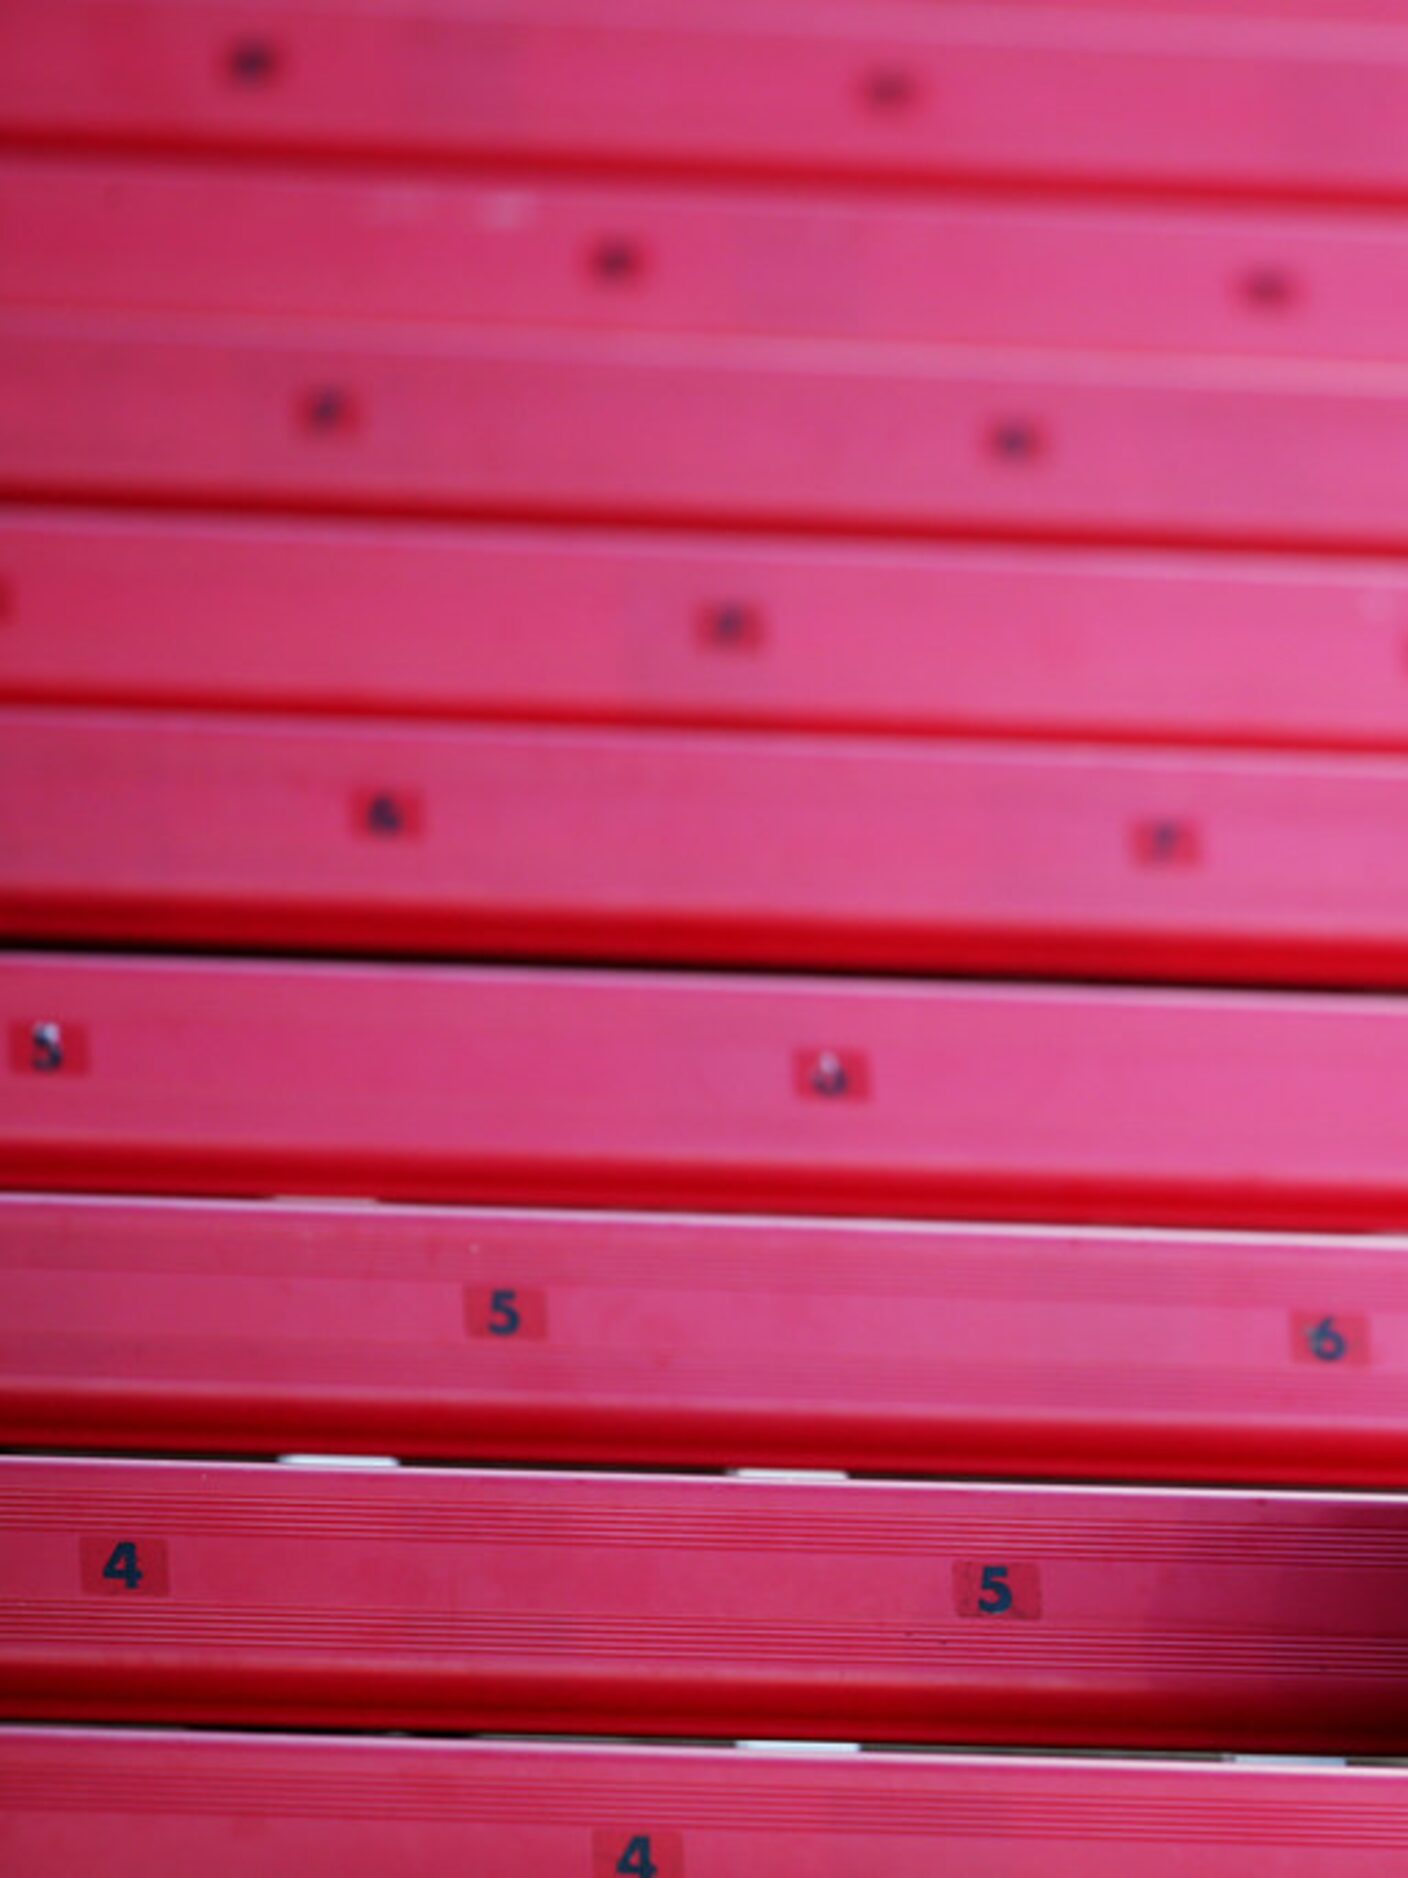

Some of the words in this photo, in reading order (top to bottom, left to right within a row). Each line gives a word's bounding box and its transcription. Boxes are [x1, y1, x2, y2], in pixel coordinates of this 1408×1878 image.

[489, 1290, 520, 1335] 5
[1308, 1318, 1346, 1361] 6
[103, 1541, 143, 1590] 4
[978, 1566, 1012, 1614] 5
[616, 1835, 657, 1878] 4
